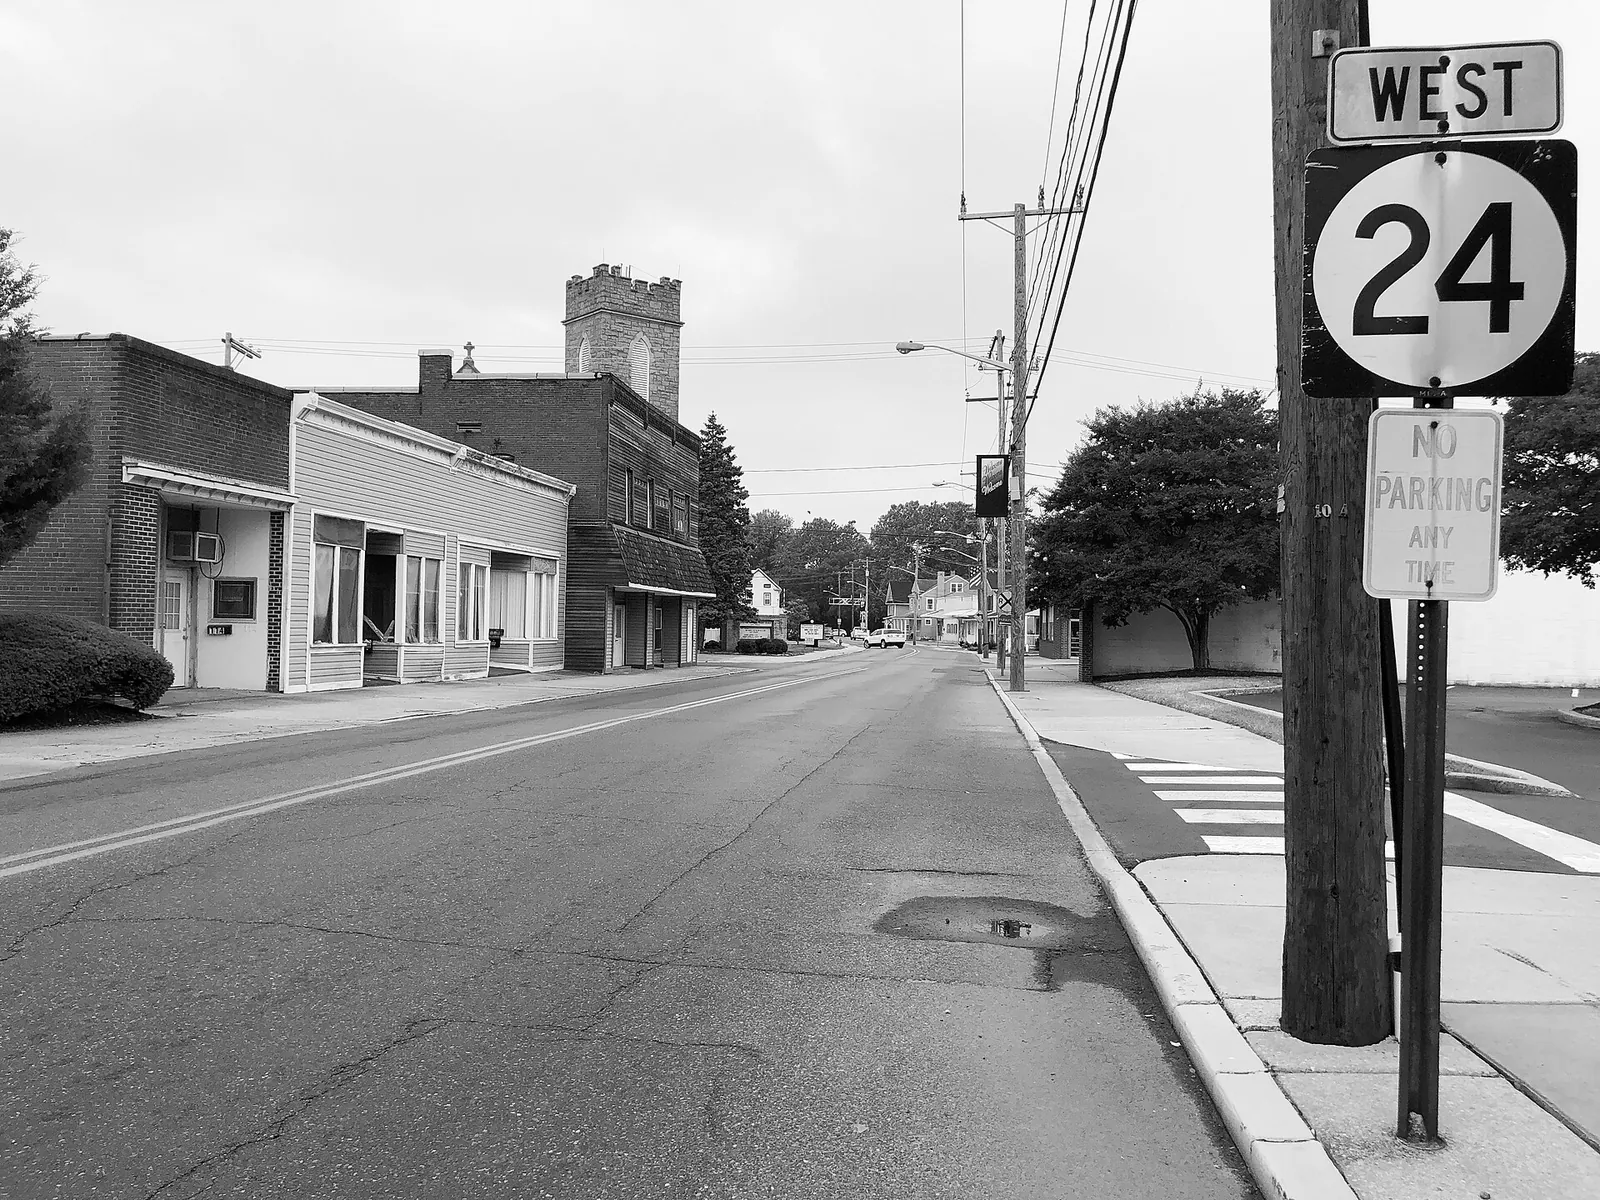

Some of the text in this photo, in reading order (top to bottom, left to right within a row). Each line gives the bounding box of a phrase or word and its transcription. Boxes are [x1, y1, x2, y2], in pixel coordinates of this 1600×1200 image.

[1369, 61, 1523, 122] WEST
[1353, 202, 1525, 335] 24
[1412, 424, 1457, 459] NO
[1375, 476, 1492, 512] PARKING
[1409, 526, 1454, 549] ANY
[1405, 560, 1456, 584] TIME
